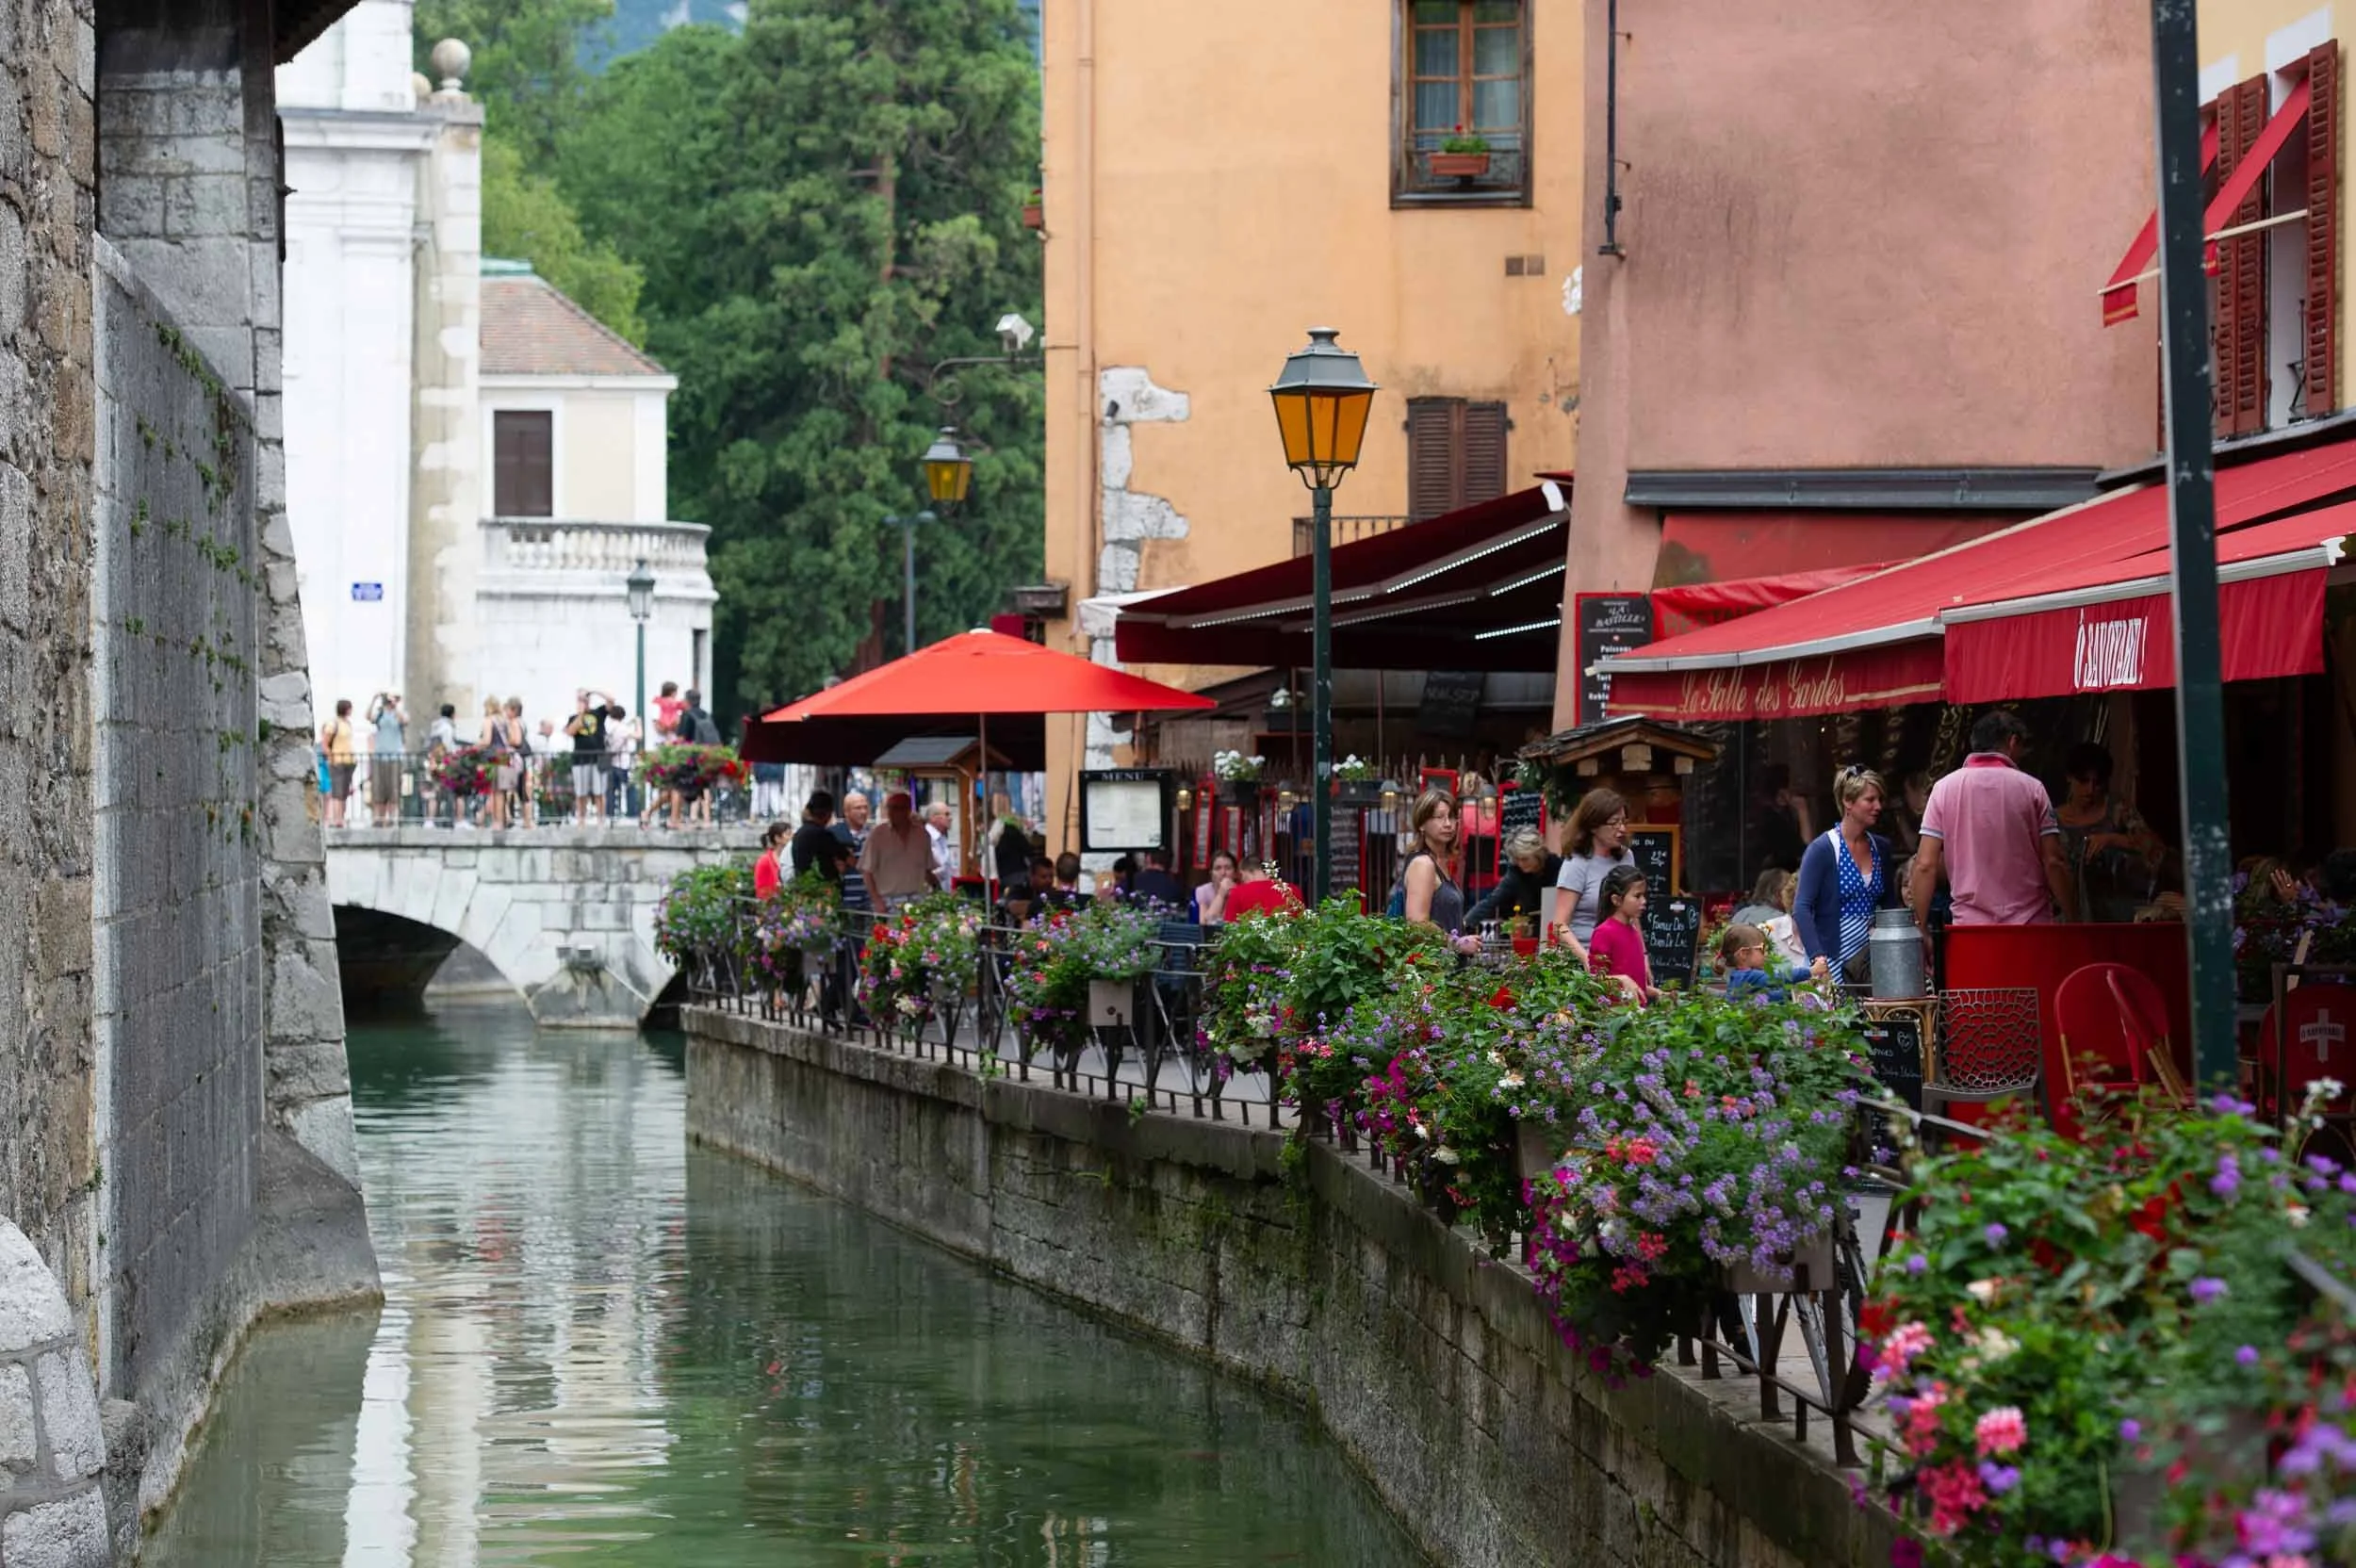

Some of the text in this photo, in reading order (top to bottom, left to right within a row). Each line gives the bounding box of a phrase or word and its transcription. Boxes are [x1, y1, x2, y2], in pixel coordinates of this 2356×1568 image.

[1678, 655, 1844, 714] La Salle des Gardes
[1102, 772, 1144, 782] MENU
